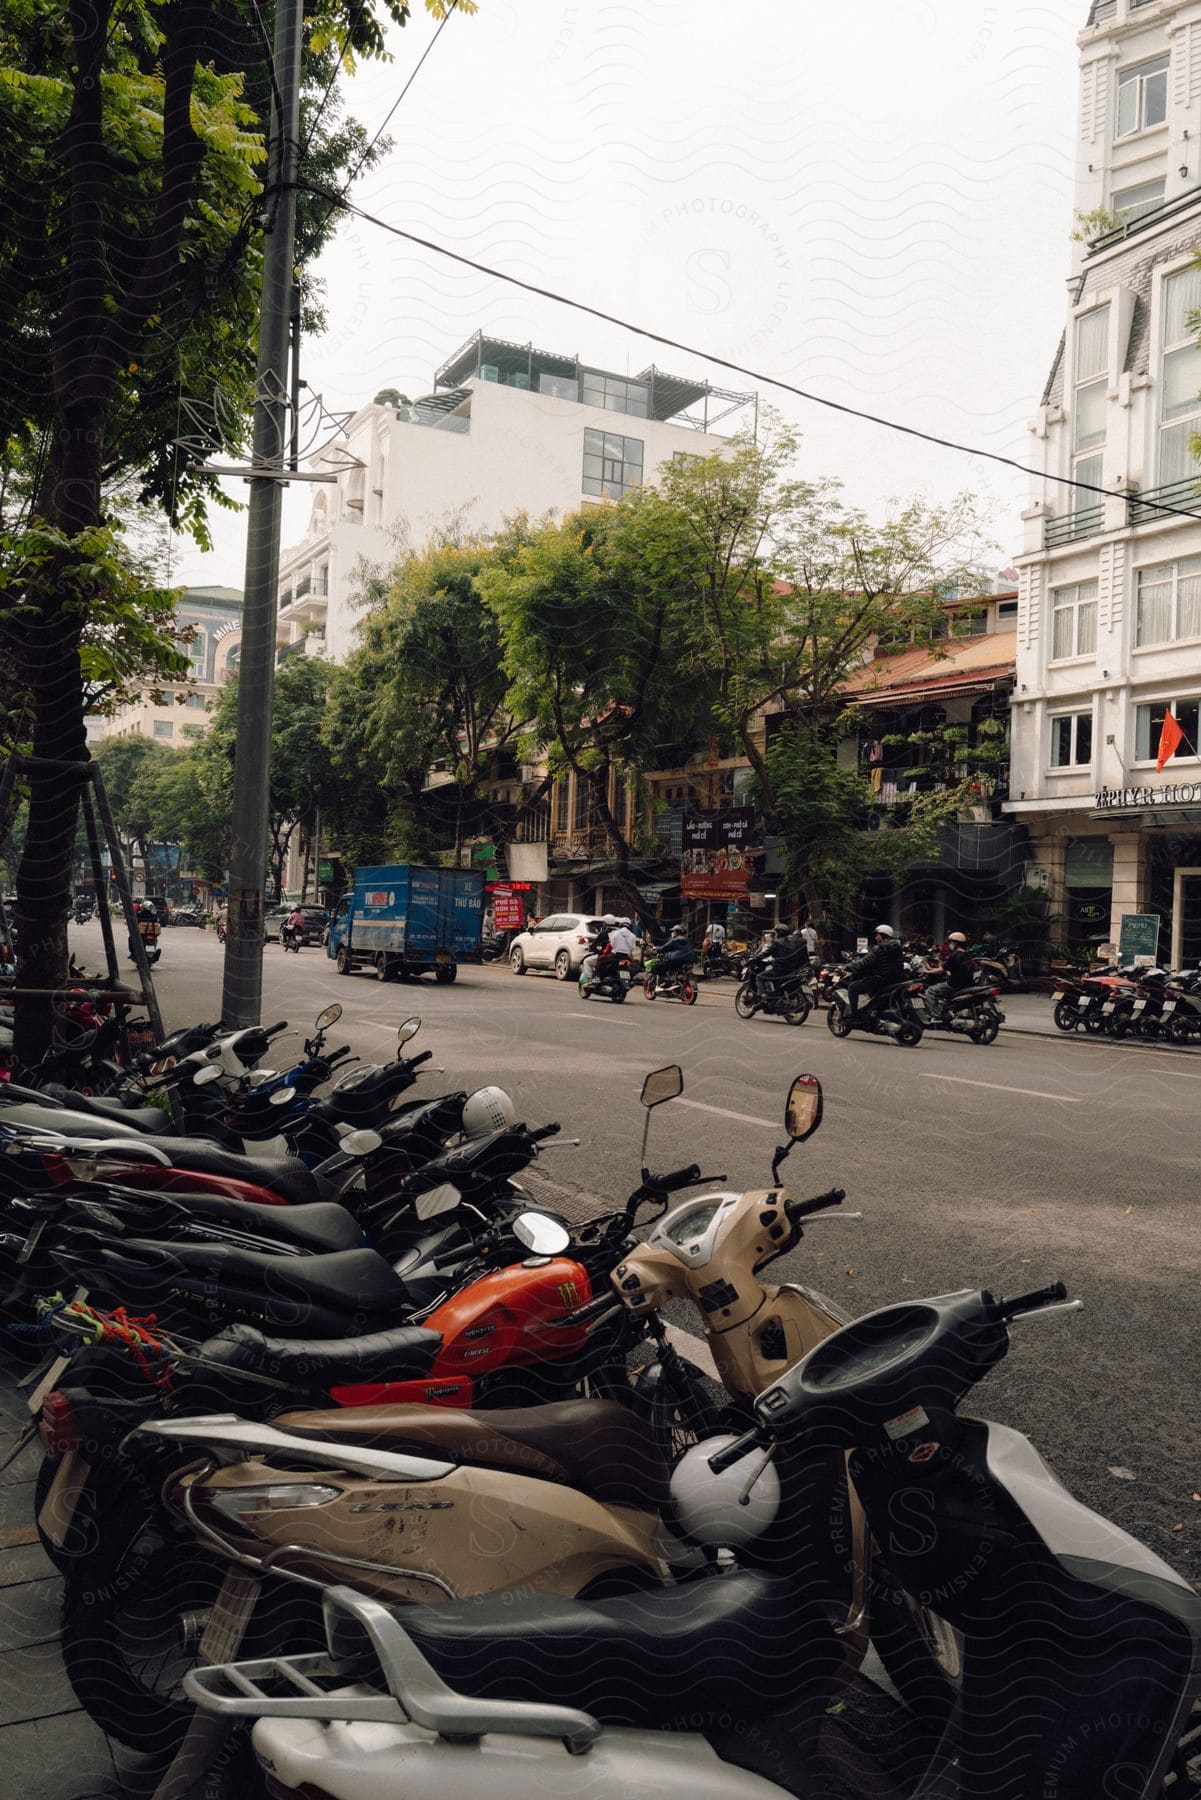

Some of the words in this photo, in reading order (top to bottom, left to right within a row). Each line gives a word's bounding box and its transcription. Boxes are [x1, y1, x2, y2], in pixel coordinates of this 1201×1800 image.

[212, 620, 241, 642] MINE
[1094, 785, 1155, 809] ZÉPHYR
[350, 1501, 454, 1513] LEAD
